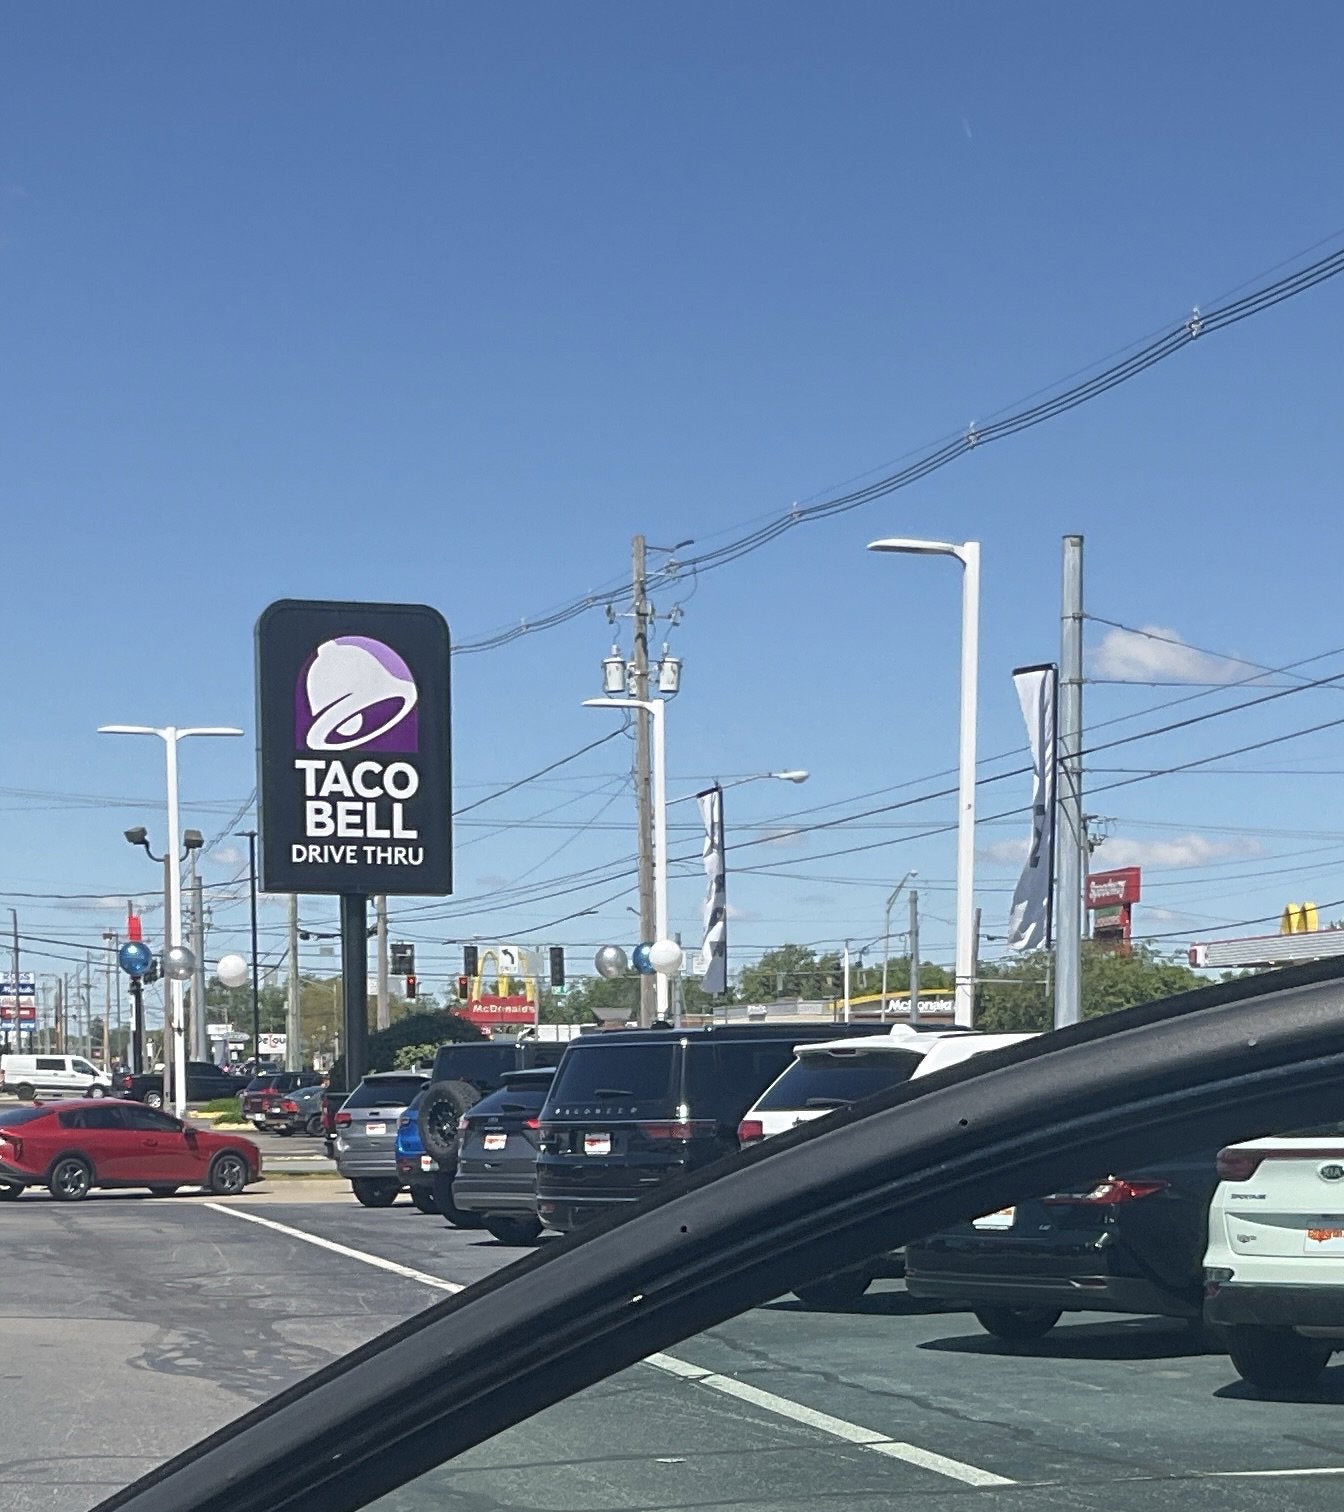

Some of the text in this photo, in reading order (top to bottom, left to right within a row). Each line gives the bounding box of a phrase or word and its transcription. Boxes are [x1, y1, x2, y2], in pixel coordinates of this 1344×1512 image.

[294, 759, 420, 800] TACO
[305, 801, 418, 840] BELL
[291, 844, 424, 866] DRIVE THRU
